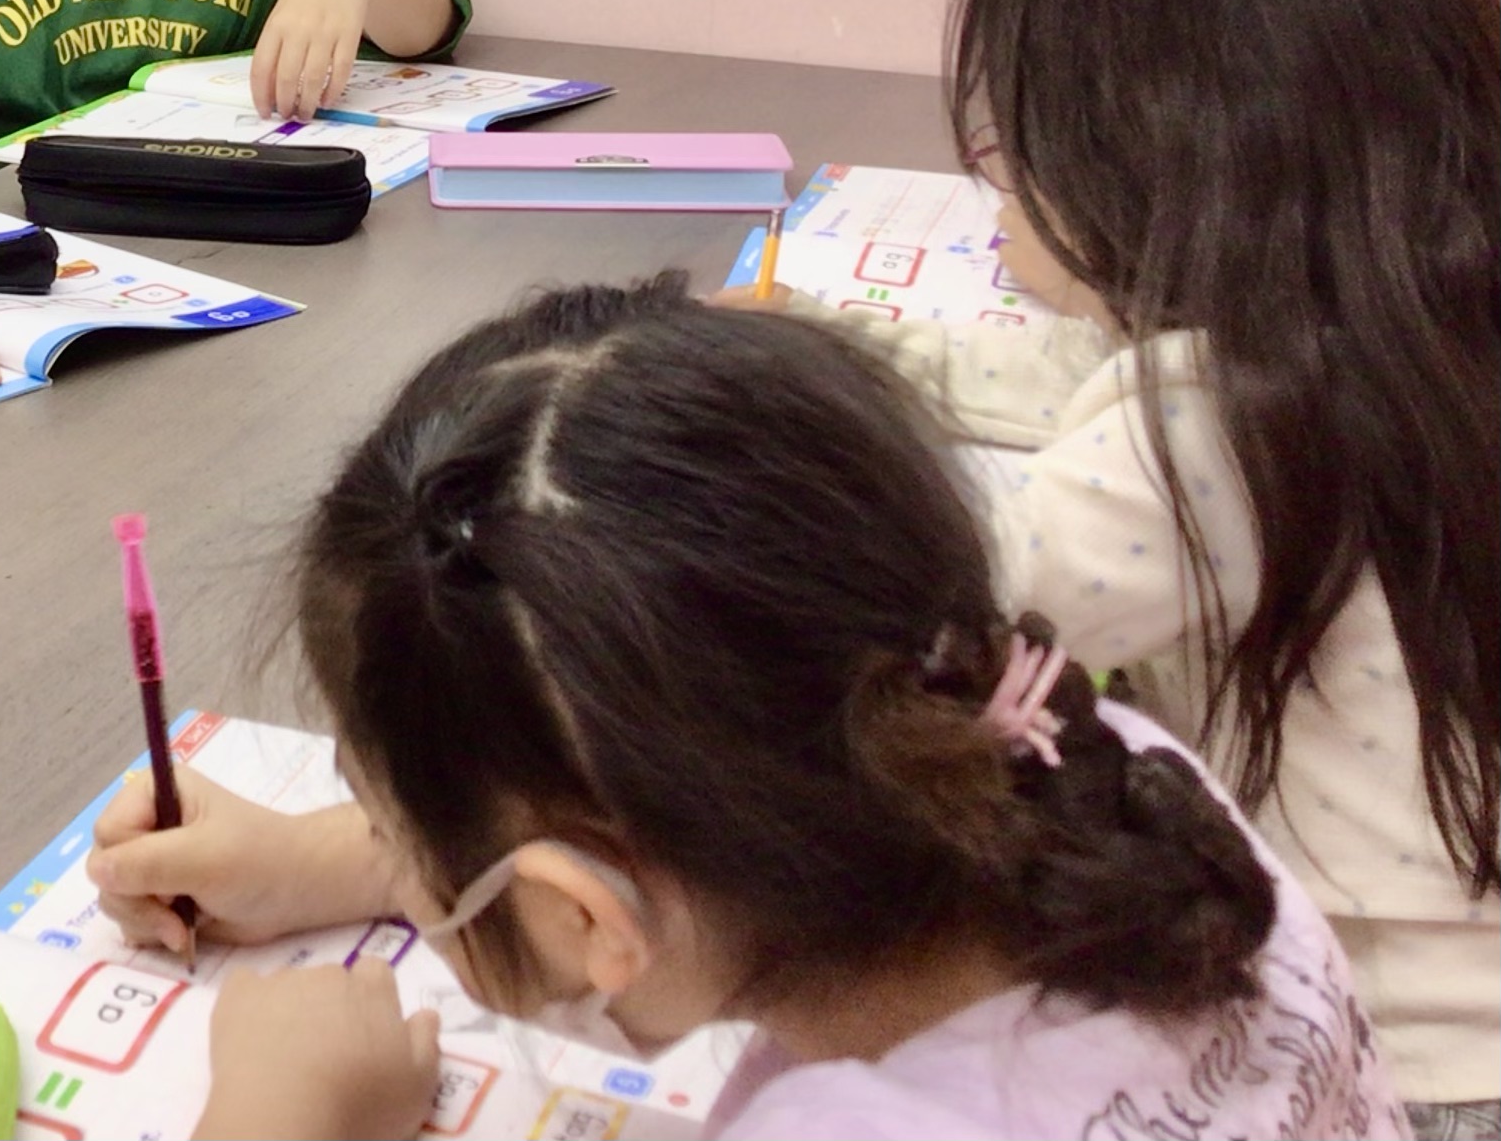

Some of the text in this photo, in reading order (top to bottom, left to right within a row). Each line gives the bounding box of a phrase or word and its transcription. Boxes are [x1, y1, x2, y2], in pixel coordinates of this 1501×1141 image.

[53, 16, 208, 66] UNIVERSITY
[143, 143, 258, 159] adidas
[97, 982, 158, 1025] ag
